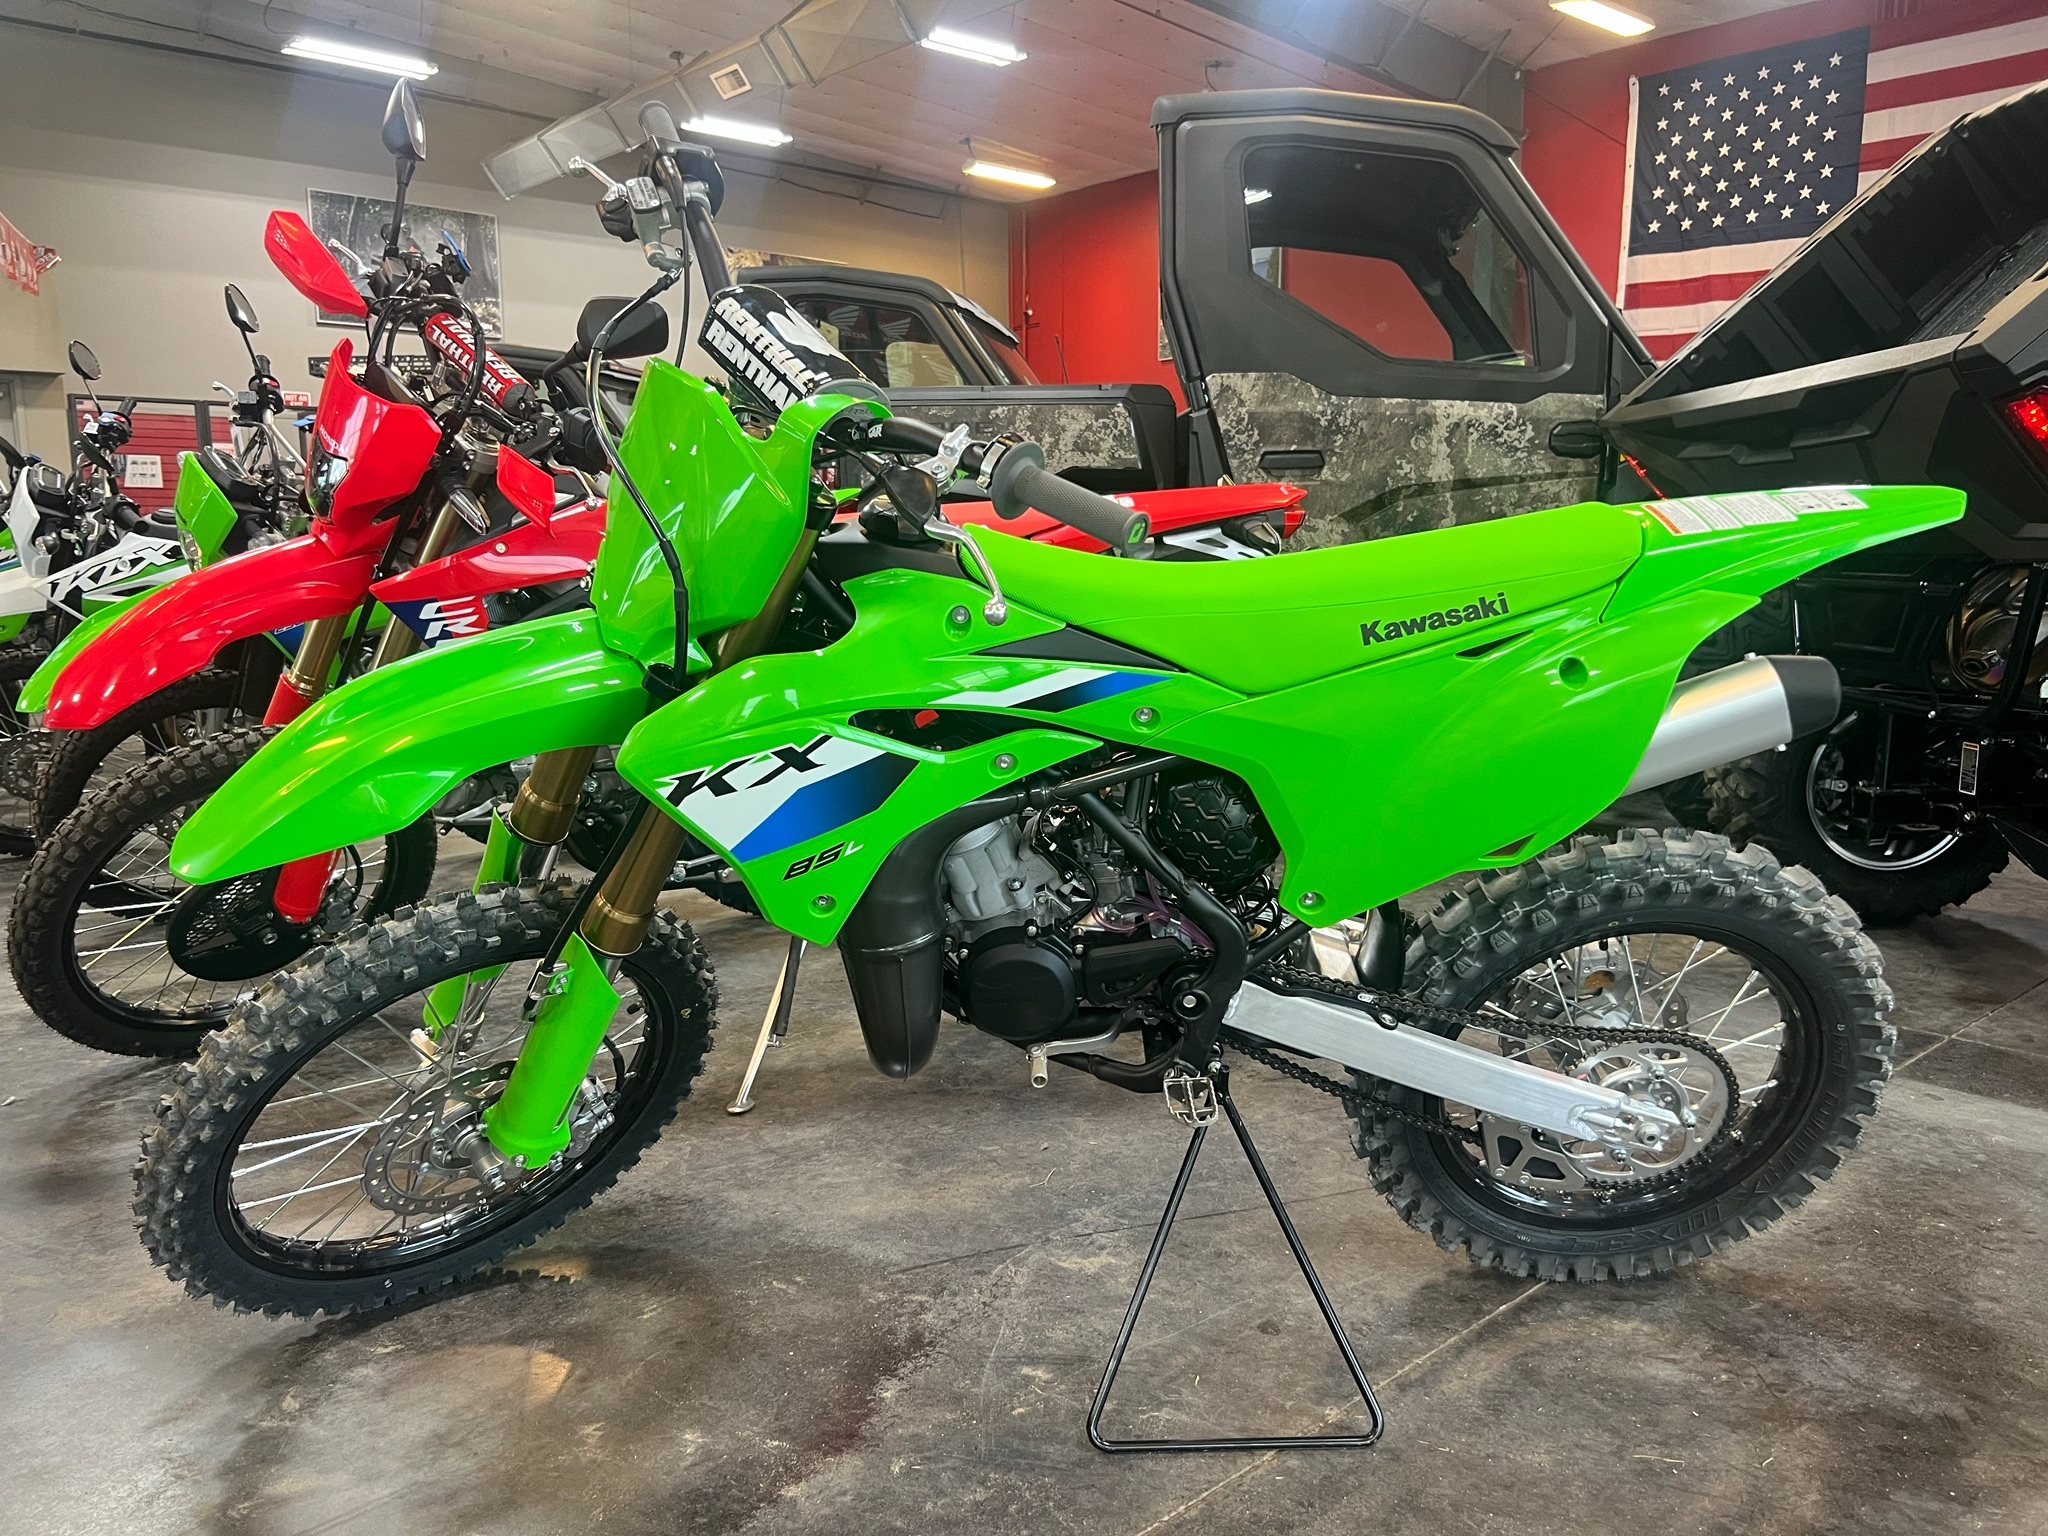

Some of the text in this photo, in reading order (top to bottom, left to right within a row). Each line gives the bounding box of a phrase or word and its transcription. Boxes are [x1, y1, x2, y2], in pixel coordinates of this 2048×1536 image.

[430, 324, 505, 396] RETHAL
[714, 297, 816, 395] RENTHAL
[50, 543, 178, 602] KLX
[1359, 592, 1510, 647] Kawasaki
[664, 734, 834, 809] KX
